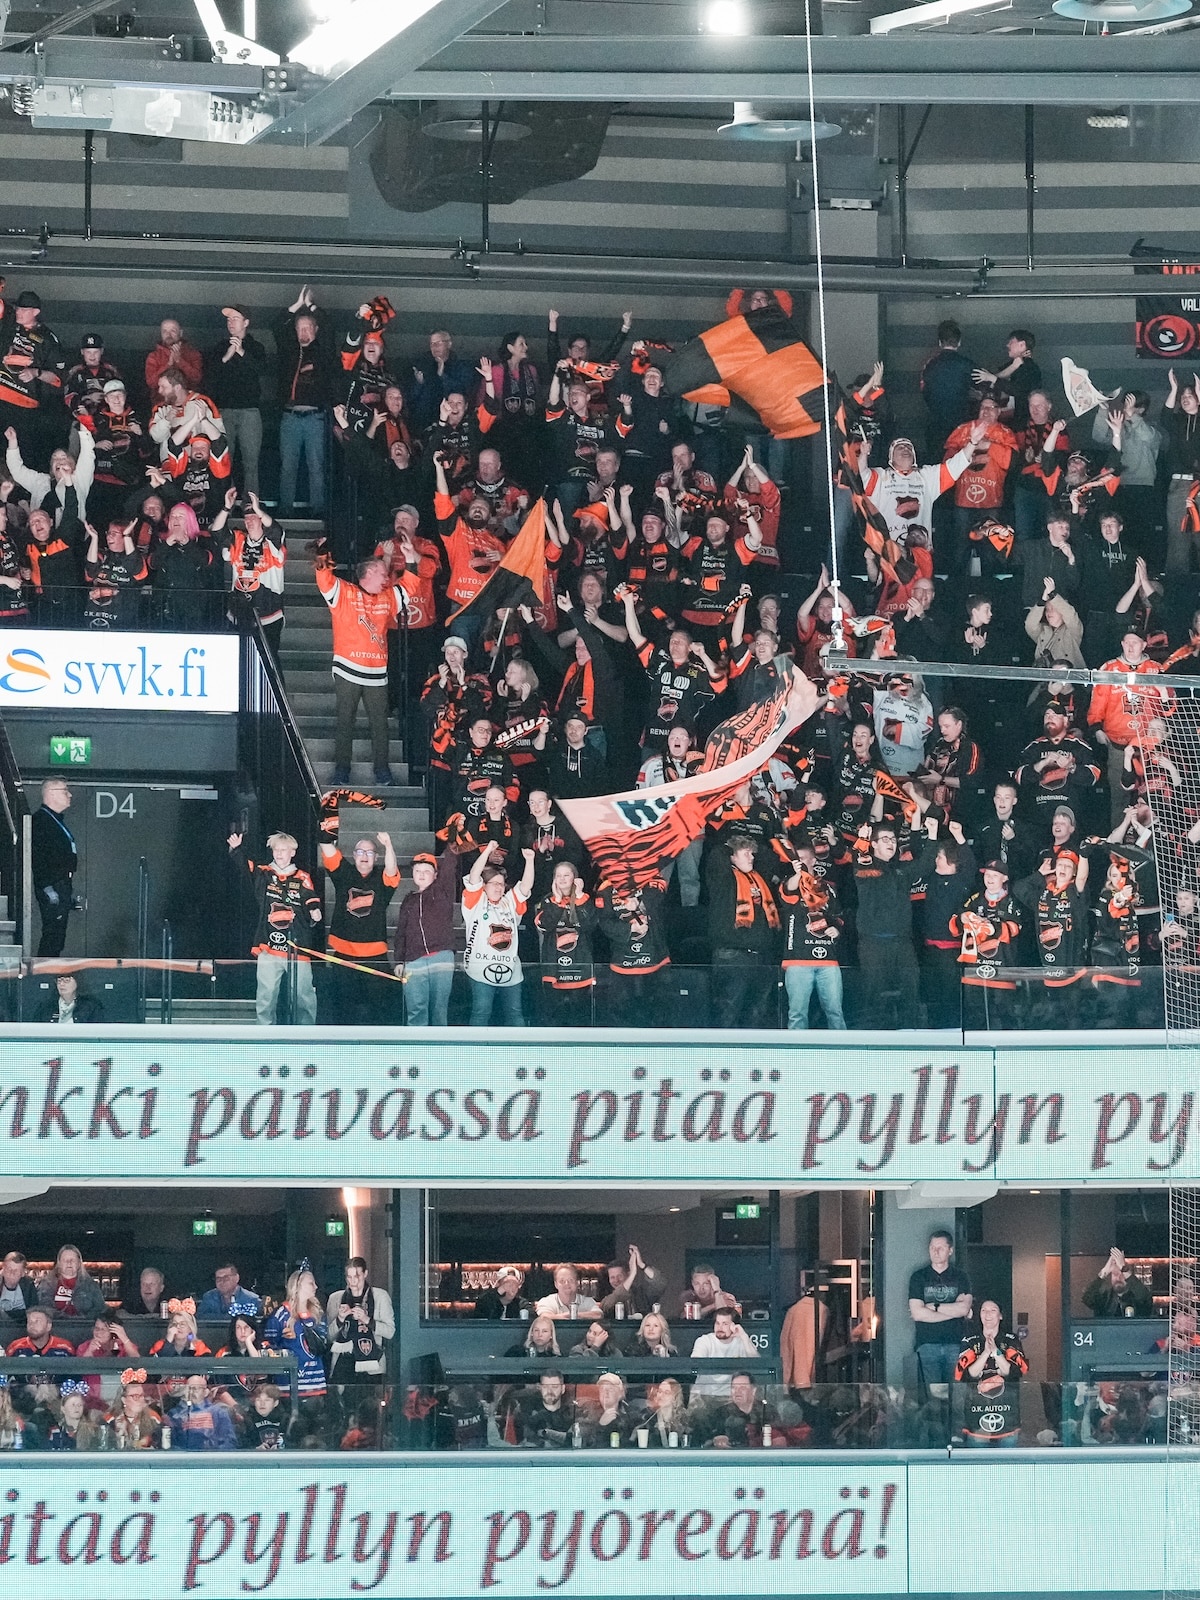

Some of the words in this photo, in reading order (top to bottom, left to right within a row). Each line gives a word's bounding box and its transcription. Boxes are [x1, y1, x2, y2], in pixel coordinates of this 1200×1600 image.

[64, 646, 209, 698] svvk.fi
[95, 791, 137, 820] D4
[491, 954, 511, 963] AUTO
[184, 1064, 546, 1167] päivässä
[567, 1066, 782, 1169] pitää
[800, 1065, 1067, 1172] pyllyn
[749, 1334, 769, 1349] 35
[1073, 1332, 1094, 1347] 34
[181, 1482, 454, 1591] pyllyn
[478, 1482, 898, 1590] pyöreänä!
